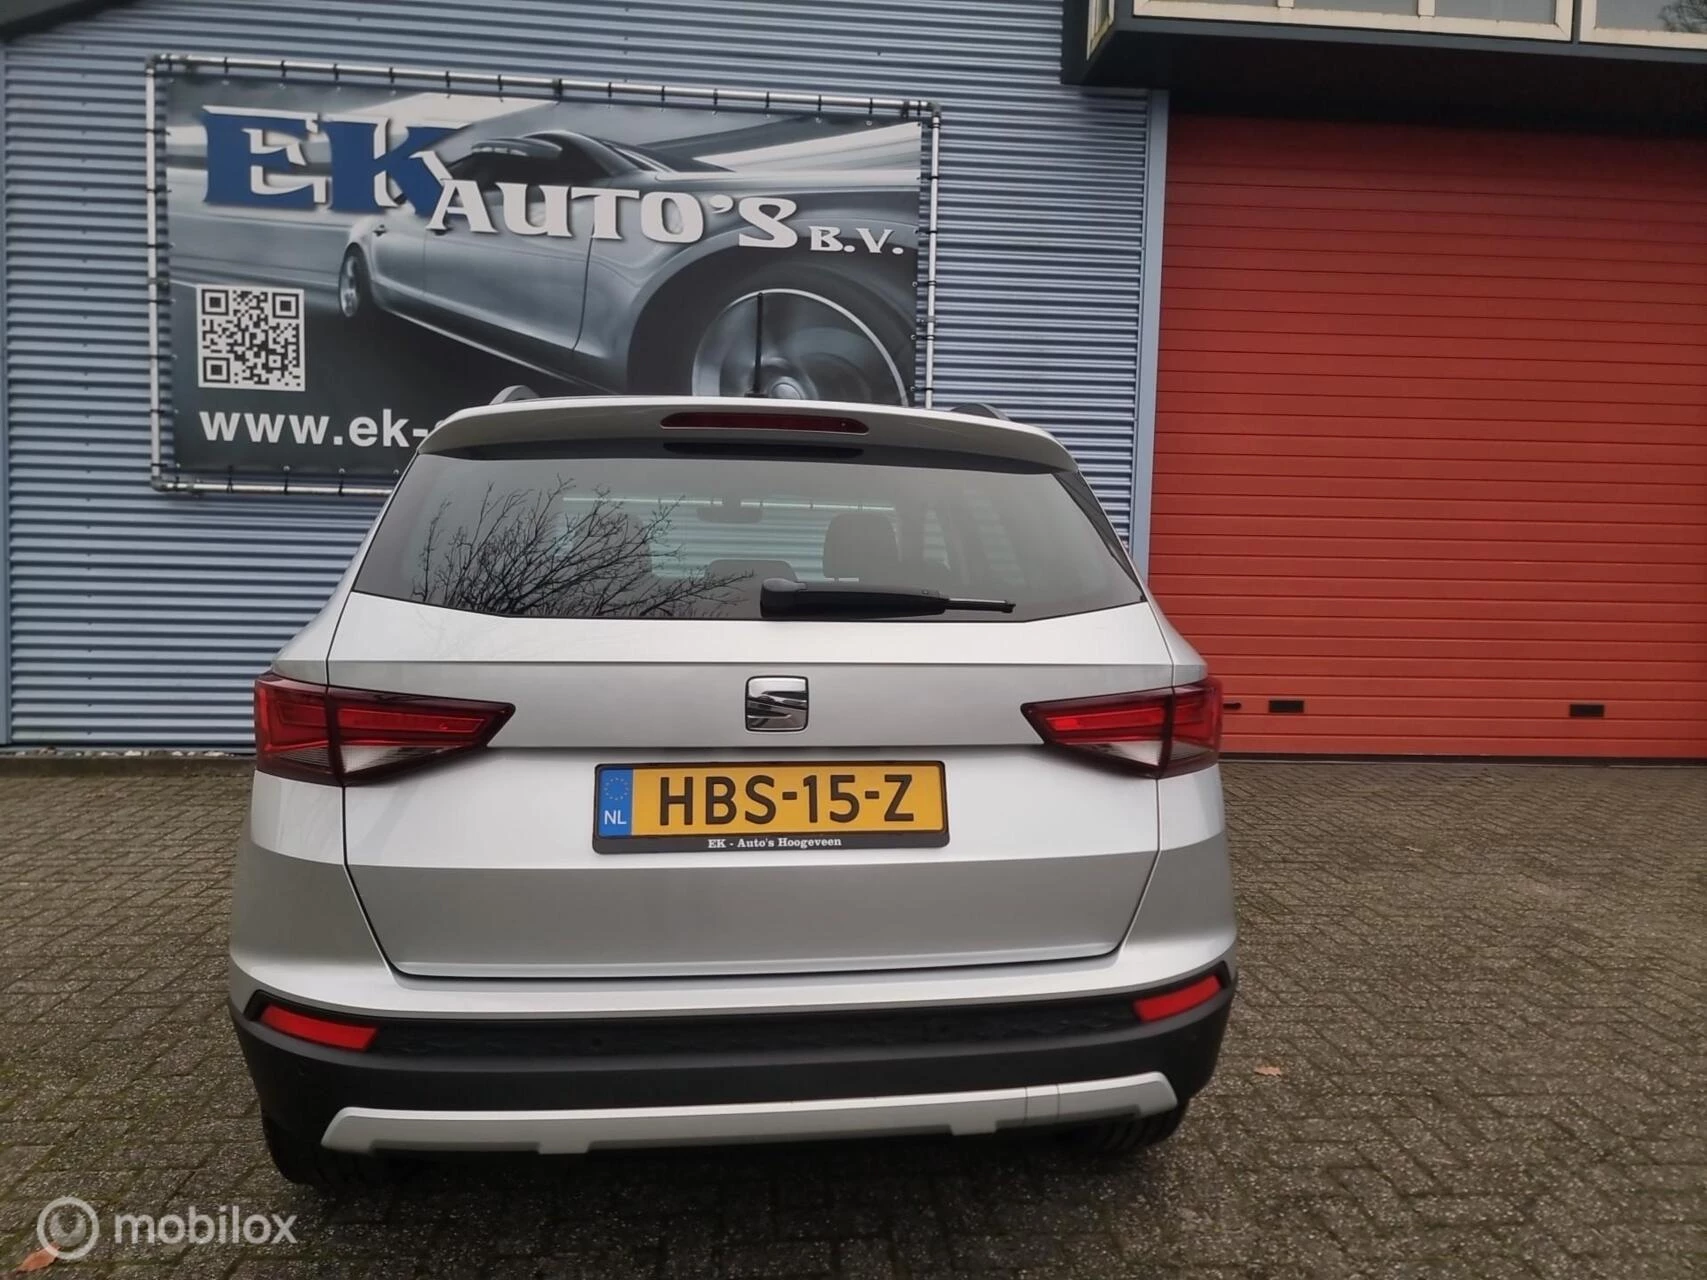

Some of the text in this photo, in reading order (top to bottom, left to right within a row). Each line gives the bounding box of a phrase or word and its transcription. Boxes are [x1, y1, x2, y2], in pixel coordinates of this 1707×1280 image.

[202, 105, 904, 255] EK AUTO'S B.V.
[199, 408, 446, 448] www.ek-
[603, 809, 627, 825] NL
[659, 774, 915, 827] HBS-15-Z
[707, 838, 727, 849] EK
[736, 837, 775, 848] Auto's
[777, 837, 842, 849] Hoogeveen
